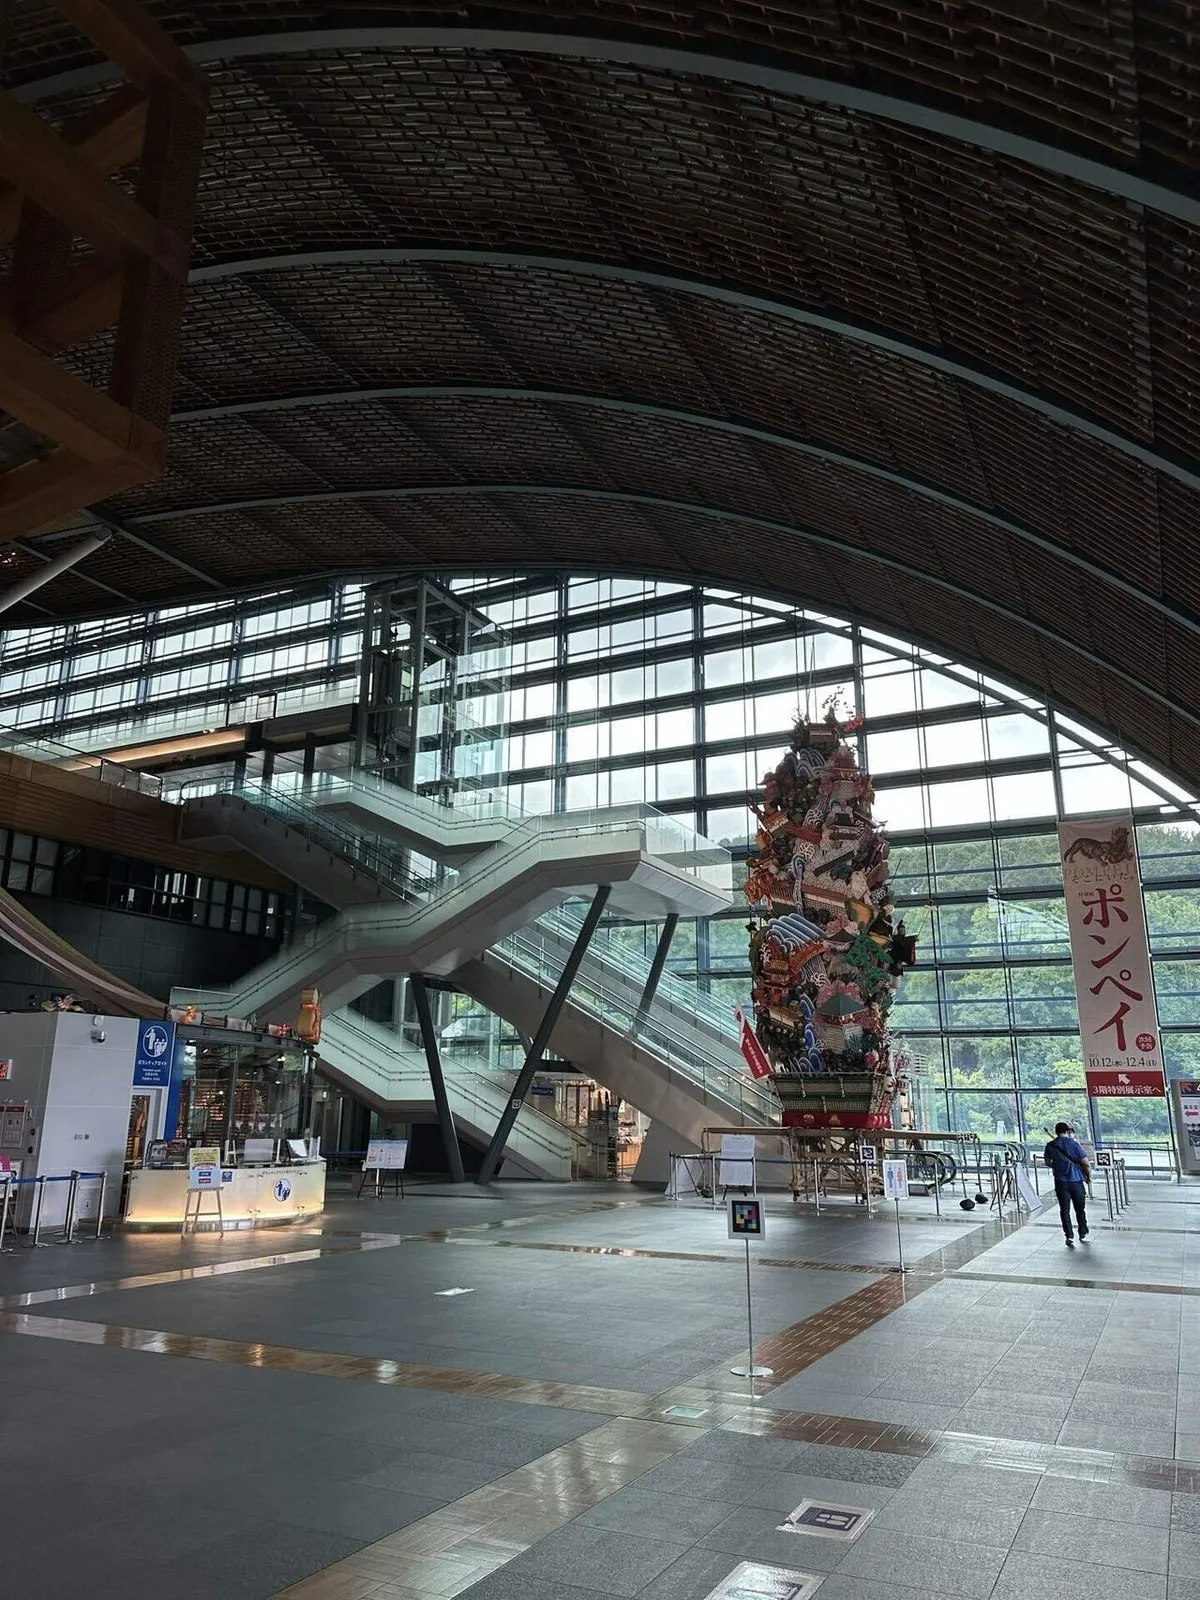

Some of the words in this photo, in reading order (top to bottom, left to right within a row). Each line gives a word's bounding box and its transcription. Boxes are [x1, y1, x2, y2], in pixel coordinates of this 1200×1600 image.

[1081, 884, 1144, 1051] ポンペイ
[1093, 1085, 1162, 1095] 3階特別展示室へ
